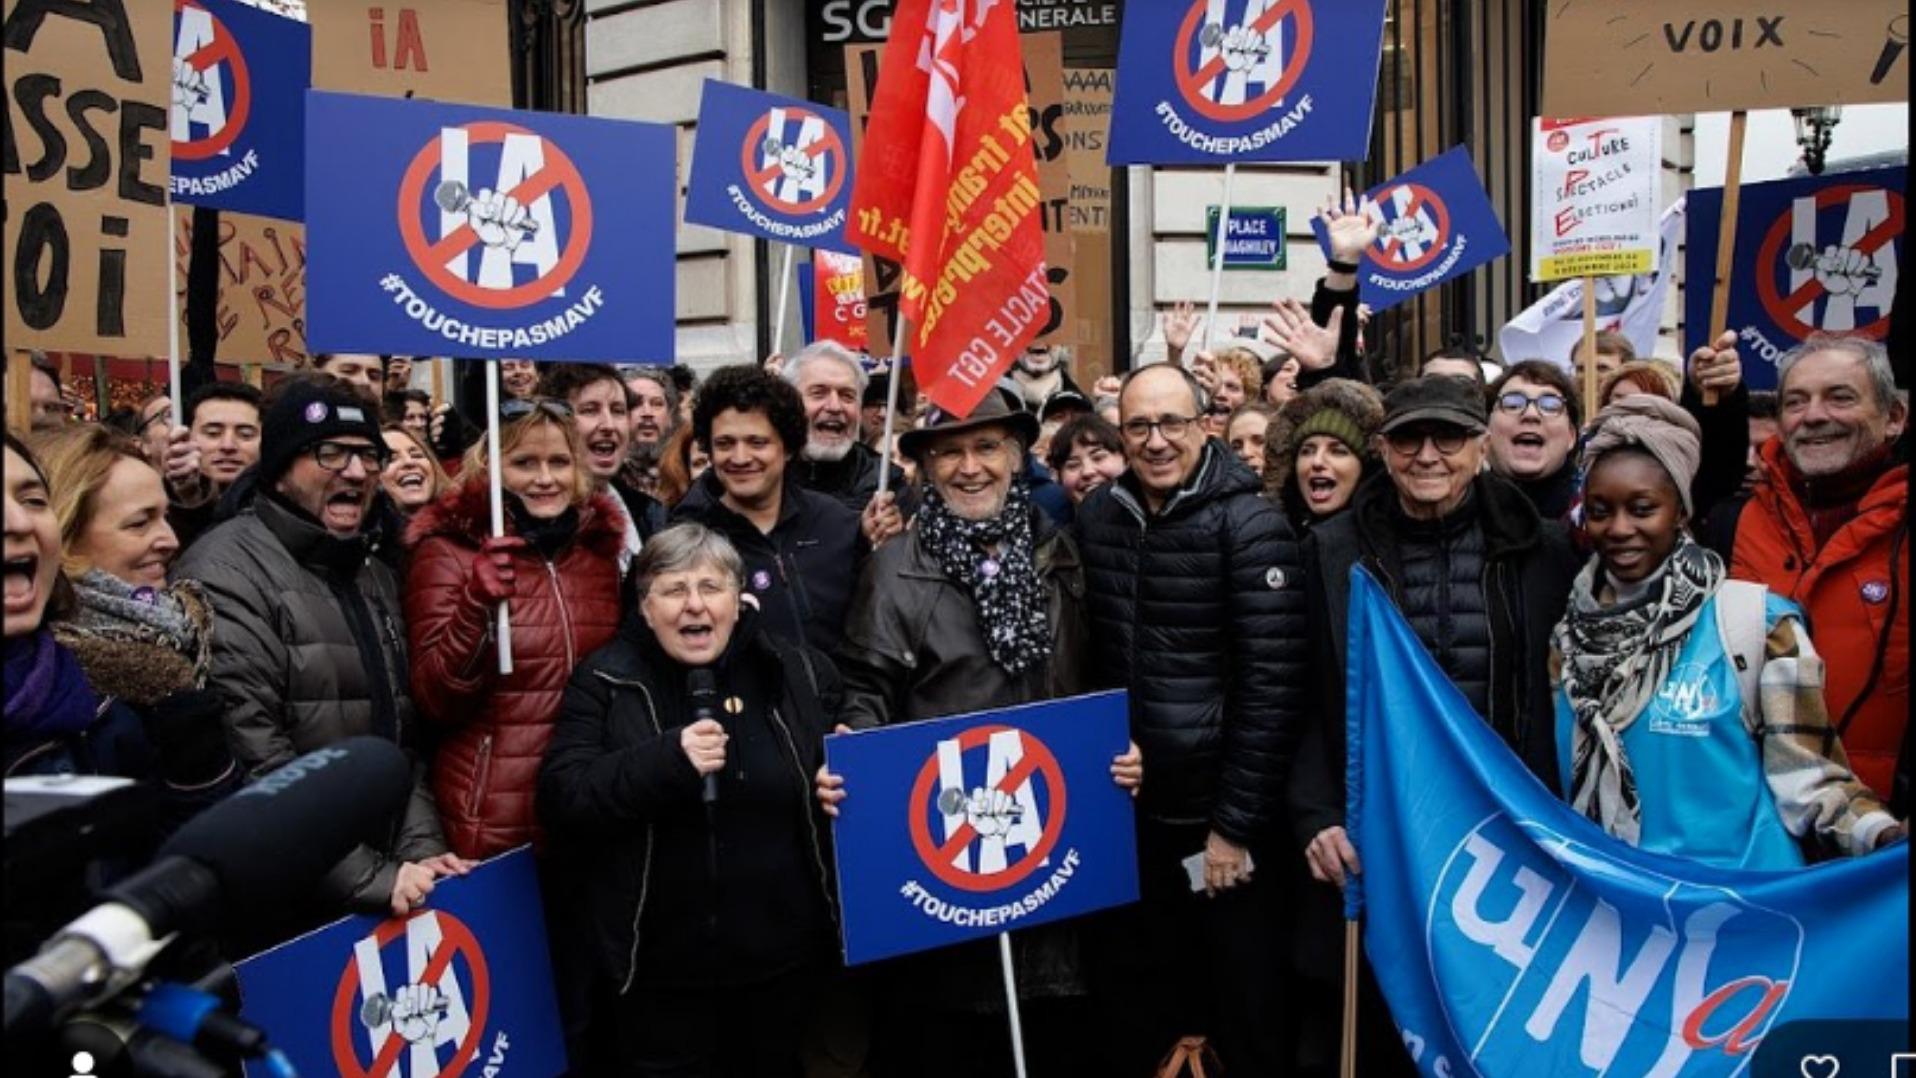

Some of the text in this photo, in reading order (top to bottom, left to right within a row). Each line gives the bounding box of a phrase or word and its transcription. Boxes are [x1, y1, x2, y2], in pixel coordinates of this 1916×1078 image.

[822, 0, 892, 41] SG
[1016, 6, 1116, 30] NERALE
[1663, 15, 1786, 53] VOIX
[1154, 94, 1315, 155] #TOUCHEPASMAVF
[1567, 129, 1630, 165] CULTURE
[1556, 163, 1632, 203] SPECTACLE
[726, 183, 846, 238] #TOUCHEPASMAVF
[1228, 219, 1267, 235] PLACE
[379, 272, 605, 348] #TOUCHEPASMAVF
[899, 847, 1082, 927] #TOUCHEPASMAVF
